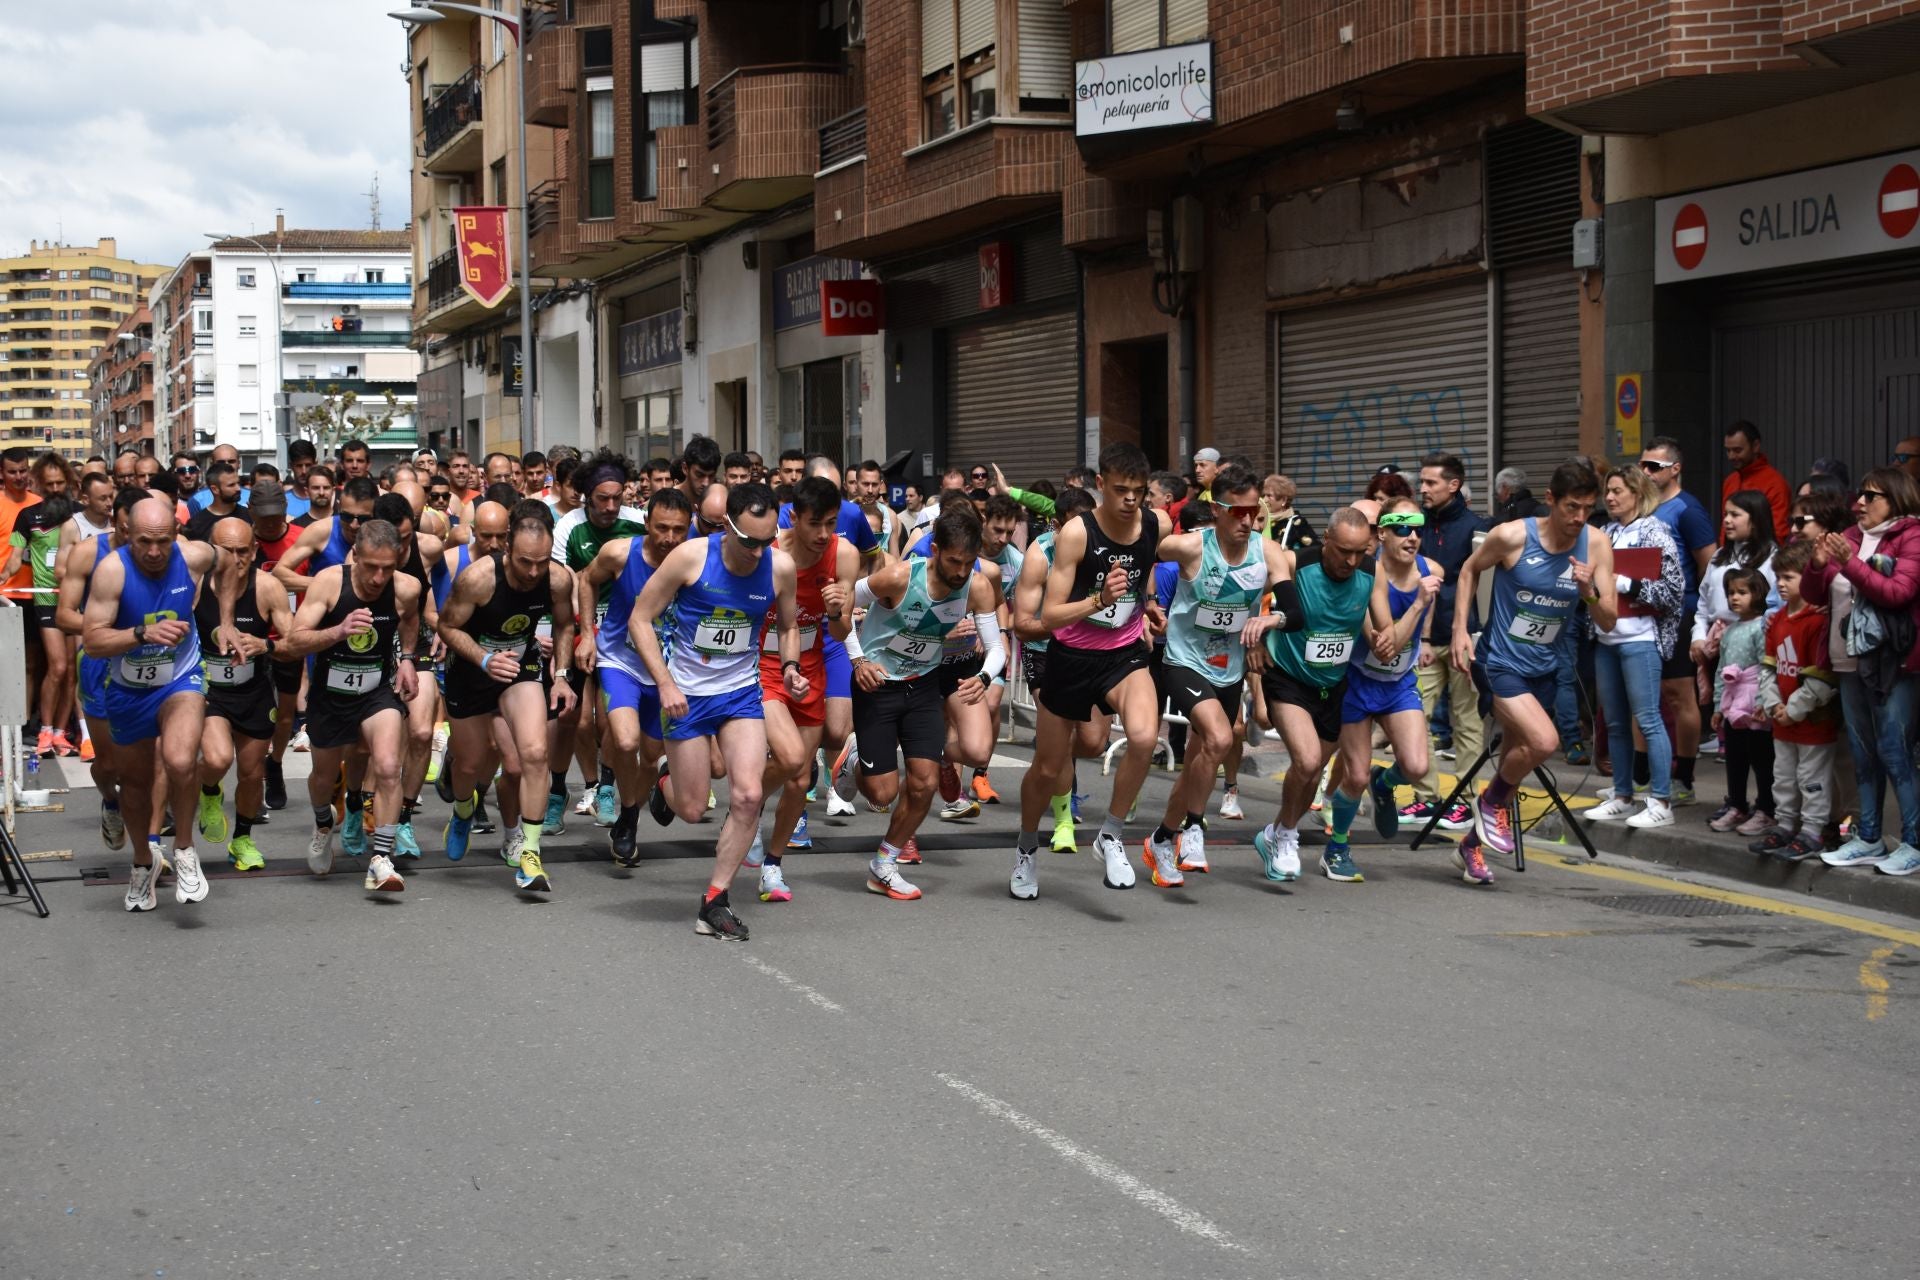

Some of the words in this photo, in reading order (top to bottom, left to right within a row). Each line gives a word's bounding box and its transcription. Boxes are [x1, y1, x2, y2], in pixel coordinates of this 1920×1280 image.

[1078, 60, 1206, 99] @monicolorlife
[1102, 94, 1170, 125] peluquería
[1738, 193, 1840, 246] SALIDA
[786, 267, 813, 298] BAZAR
[815, 258, 839, 290] HONG
[841, 259, 854, 280] DA
[892, 487, 903, 502] P
[1534, 594, 1570, 608] Chiruca
[1105, 604, 1117, 618] 3
[1212, 612, 1233, 626] 33
[712, 629, 736, 645] 40
[1526, 623, 1547, 638] 24
[903, 641, 927, 655] 20
[1316, 643, 1344, 658] 259
[1380, 655, 1400, 668] 3
[136, 666, 157, 680] 13
[224, 666, 234, 679] 8
[344, 673, 363, 687] 41
